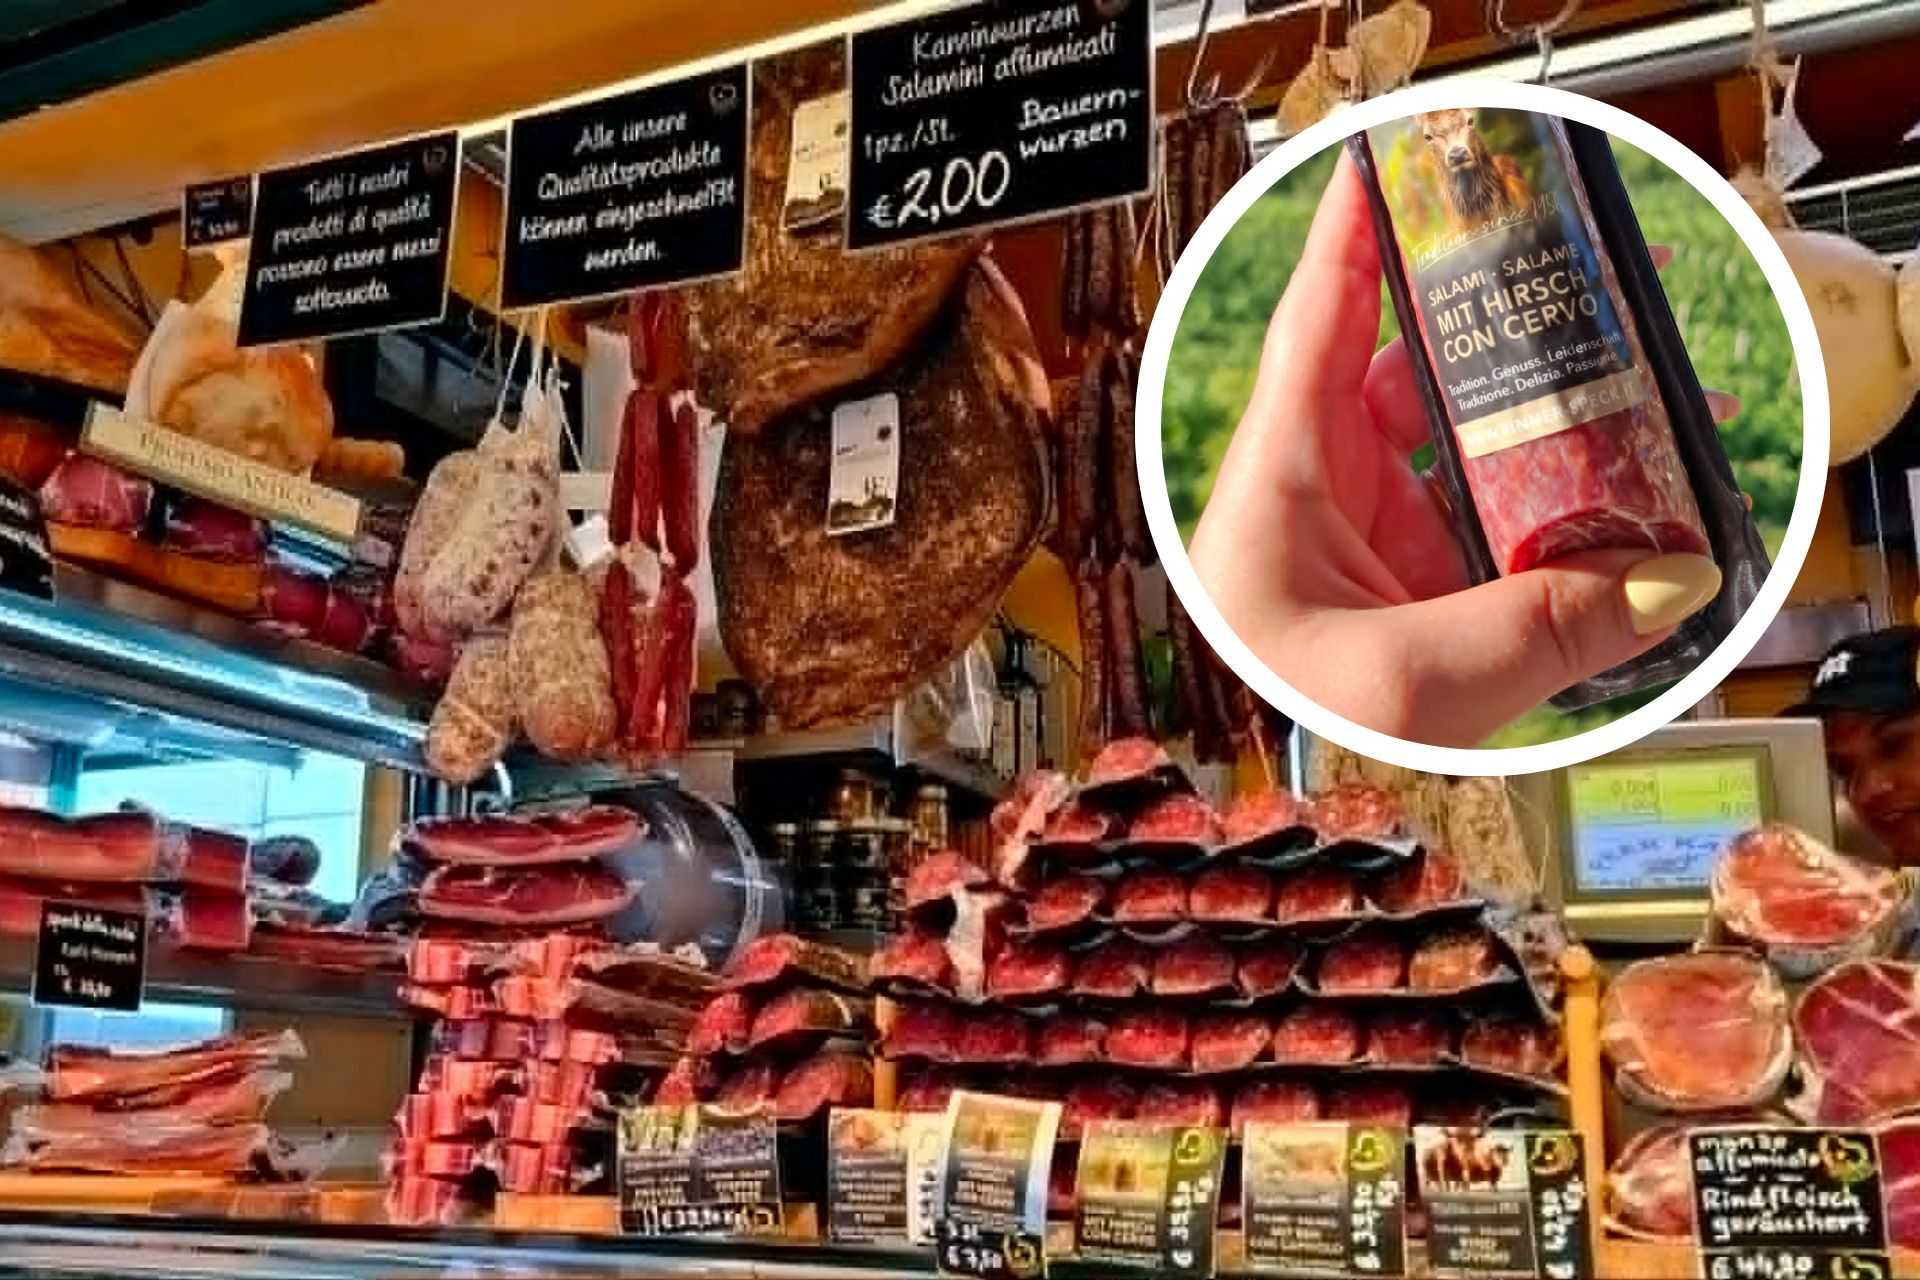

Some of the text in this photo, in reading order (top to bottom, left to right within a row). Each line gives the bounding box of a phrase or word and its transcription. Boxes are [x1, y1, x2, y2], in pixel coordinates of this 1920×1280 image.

[882, 22, 1117, 106] Salamini affumicati
[1017, 88, 1143, 131] Bauern-
[574, 112, 687, 156] Alle unsere
[1019, 118, 1127, 160] wurzen
[304, 172, 345, 206] Tutti
[359, 162, 410, 194] nostri
[273, 208, 346, 254] prodotti
[349, 206, 368, 233] di
[520, 216, 587, 244] können
[256, 255, 328, 292] possono
[333, 247, 387, 271] essere
[1428, 242, 1580, 307] SALAMI SALAME
[1436, 266, 1588, 336] MIT HIRSCH
[1443, 292, 1598, 364] CON CERVO
[1447, 375, 1491, 398] Tradition.
[1492, 358, 1547, 379] Genuss.
[1456, 386, 1514, 413] Tradizione.
[1514, 367, 1565, 393] Delizia.
[1702, 1183, 1861, 1213] Rindfleisch
[1711, 1208, 1870, 1242] geräuchert
